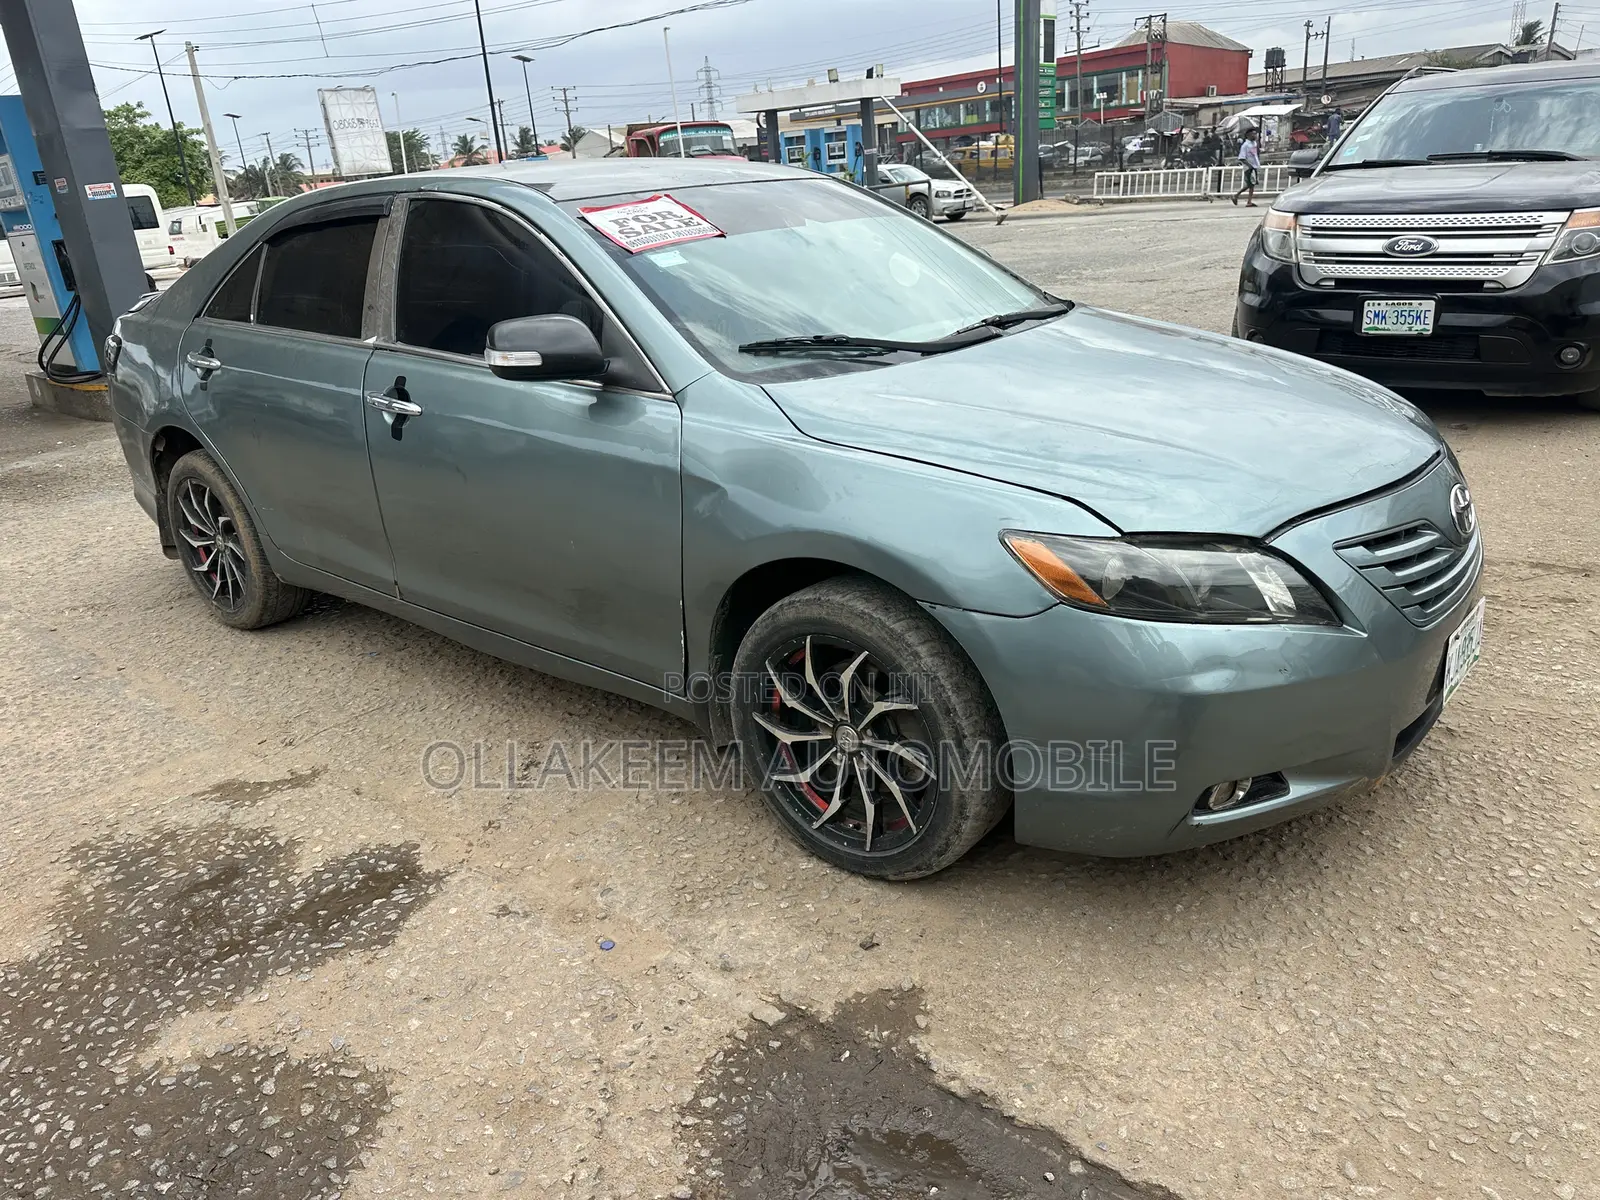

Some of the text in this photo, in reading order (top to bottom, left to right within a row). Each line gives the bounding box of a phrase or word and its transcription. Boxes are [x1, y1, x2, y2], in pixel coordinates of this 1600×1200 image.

[609, 210, 684, 228] FOR
[618, 217, 703, 239] SALE
[1394, 239, 1424, 251] Ford
[1365, 309, 1431, 325] SMK-355KE
